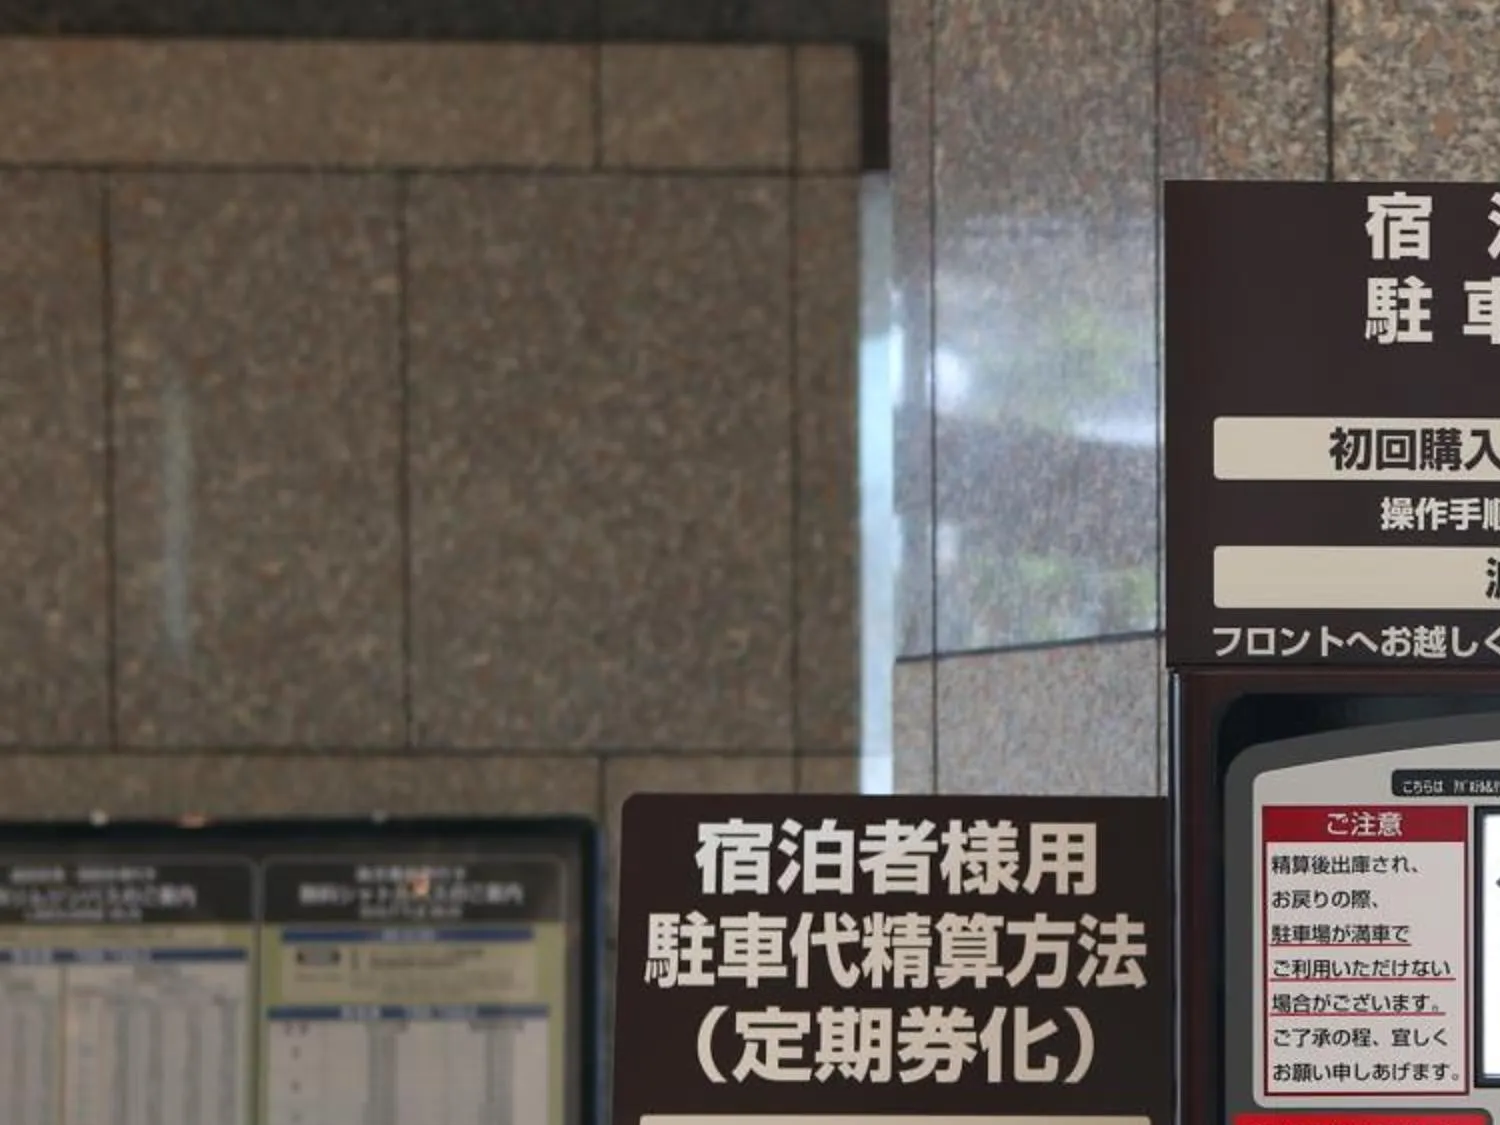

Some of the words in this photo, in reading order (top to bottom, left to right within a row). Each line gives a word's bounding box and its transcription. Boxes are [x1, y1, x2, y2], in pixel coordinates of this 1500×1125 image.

[1403, 780, 1444, 793] こちらは
[1326, 812, 1403, 837] ご注意
[695, 818, 1098, 895] 宿泊者様用
[1271, 855, 1418, 875] 精算後出庫され、
[1271, 890, 1379, 910] お戻りの際、
[1271, 924, 1410, 944] 駐車場が満車で
[645, 911, 1148, 989] 駐車代精算方法
[1272, 958, 1451, 979] ご利用いただけない
[1272, 993, 1440, 1014] 場合がございます。
[1272, 1028, 1448, 1048] ご了承の程、宜しく
[1272, 1062, 1460, 1083] お願い申しあげます。
